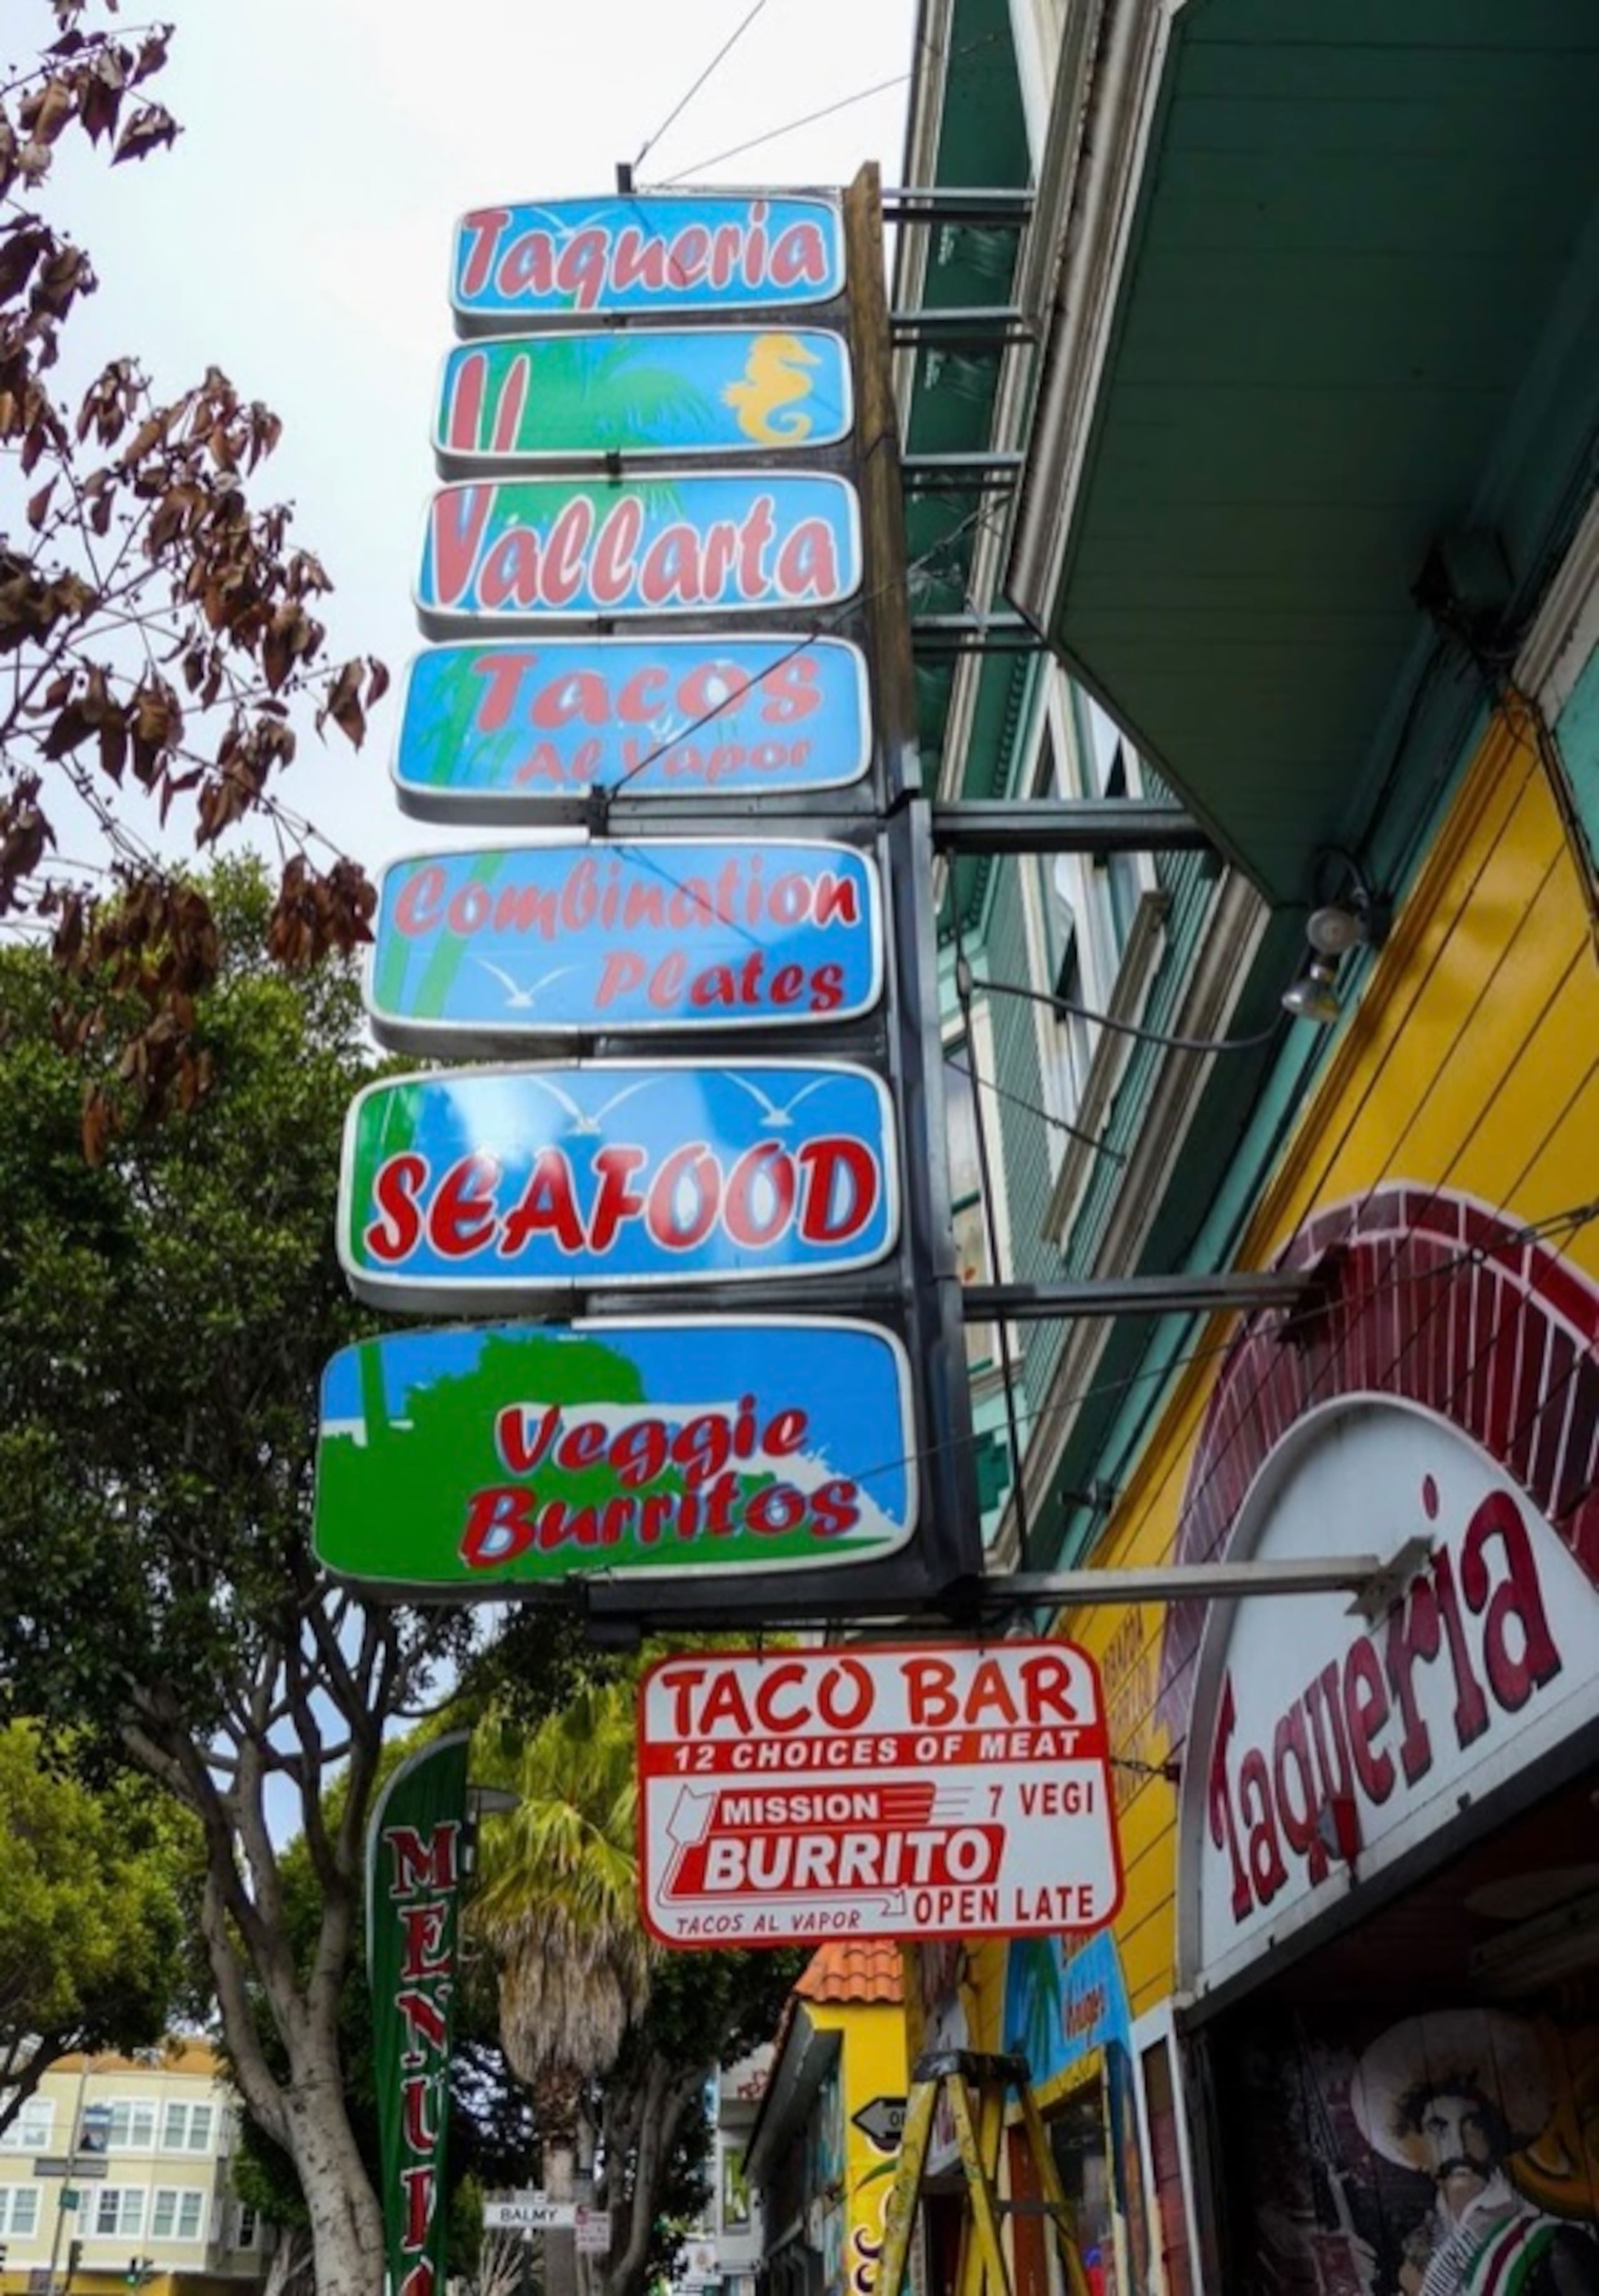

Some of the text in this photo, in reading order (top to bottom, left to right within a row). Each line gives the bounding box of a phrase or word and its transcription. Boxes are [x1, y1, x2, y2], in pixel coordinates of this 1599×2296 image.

[460, 199, 826, 310] Taqueria
[470, 653, 822, 732] Tacos
[515, 736, 811, 784] Al Vapor
[392, 857, 861, 941] Combination
[595, 951, 844, 1013] Plates
[365, 1135, 879, 1264] SEAFOOD
[495, 1393, 808, 1487] Veggie
[458, 1468, 861, 1570] Burritos
[661, 1656, 1078, 1737] TACO BAR
[1209, 1474, 1563, 1925] Taqueria
[675, 1729, 1081, 1771] 12 CHOICES OF MEAT
[721, 1792, 879, 1825] MISSION
[989, 1781, 1094, 1817] 7 VEGI
[703, 1829, 991, 1891] BURRITO
[676, 1910, 861, 1935] TACOS AL VAPOR
[913, 1886, 1094, 1925] OPEN LATE
[500, 2207, 557, 2222] BALMY
